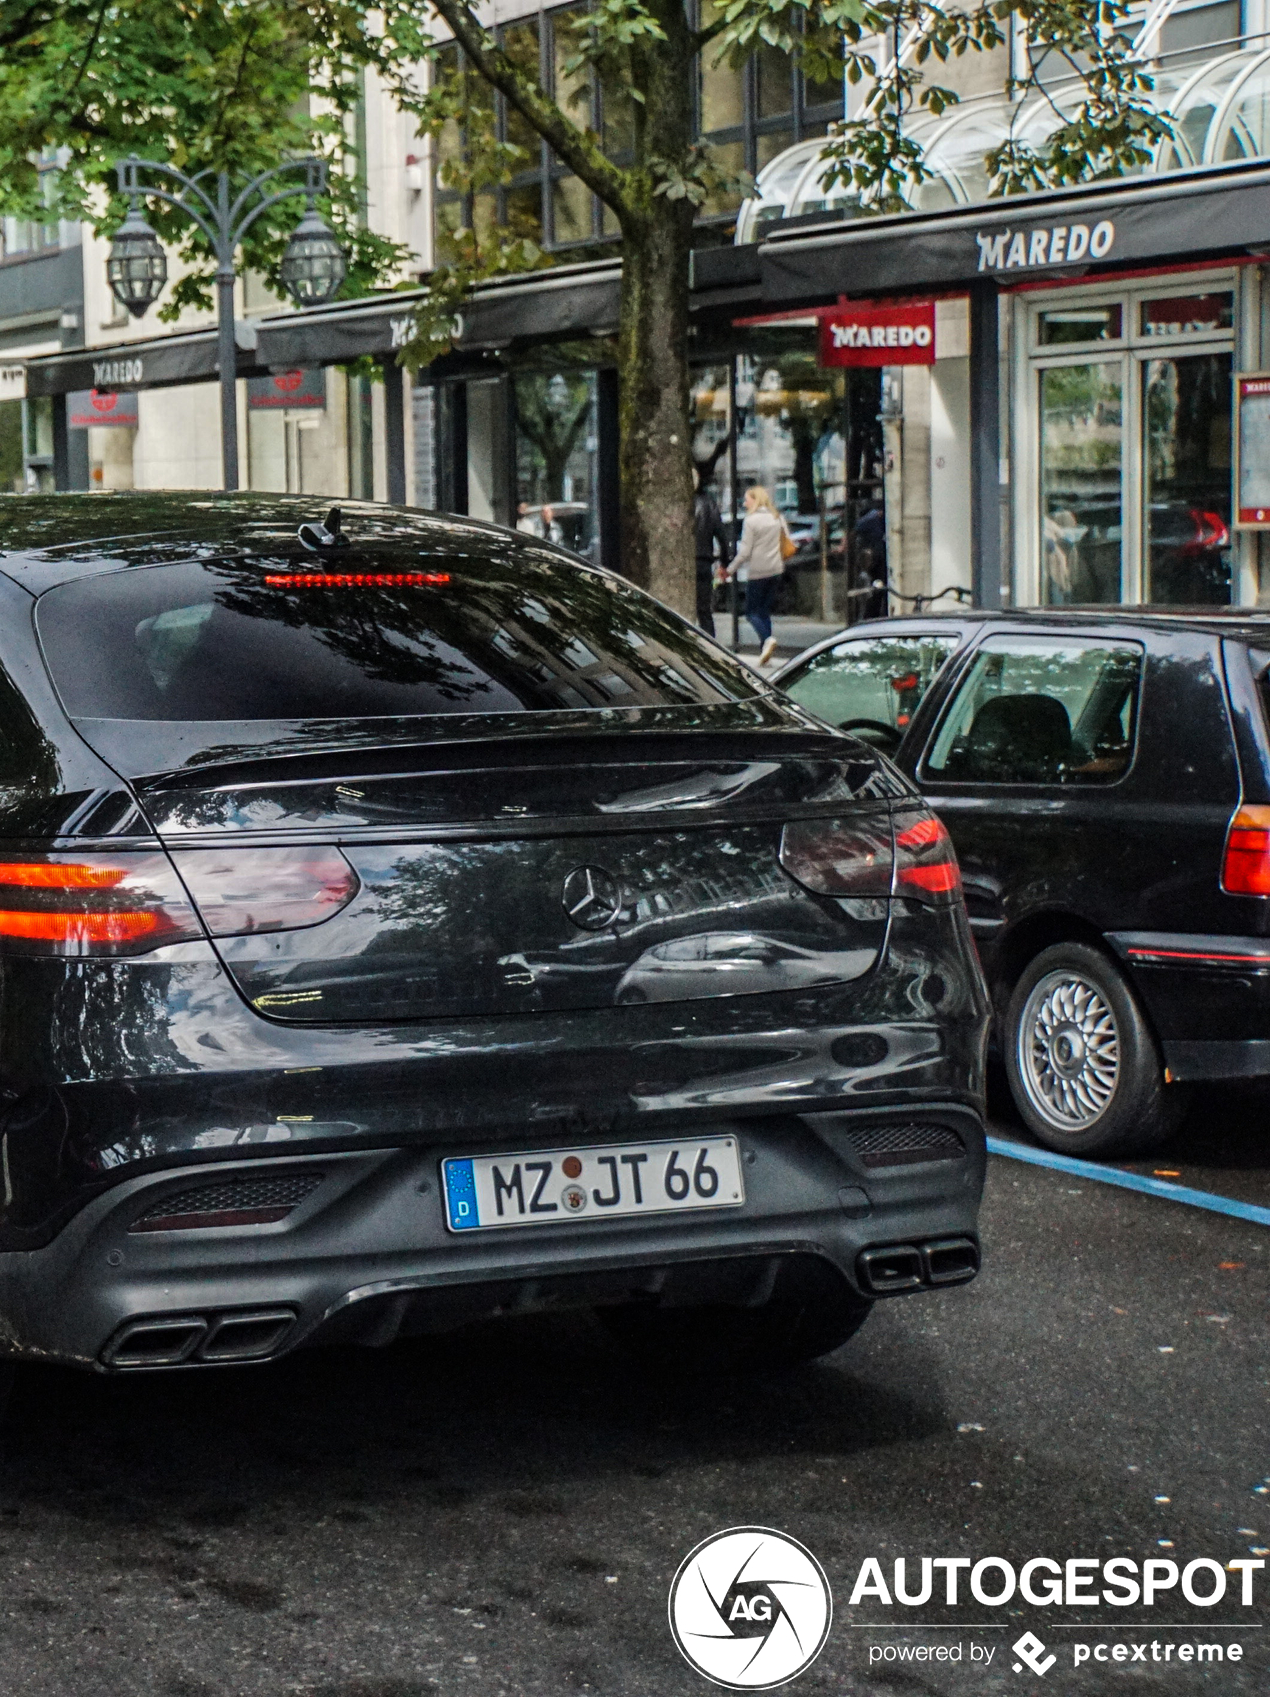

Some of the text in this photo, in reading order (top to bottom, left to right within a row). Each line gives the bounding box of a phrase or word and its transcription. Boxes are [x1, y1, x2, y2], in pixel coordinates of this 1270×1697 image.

[976, 220, 1115, 272] MAREDO
[830, 323, 931, 347] MAREDO
[92, 359, 143, 386] MAREDO
[458, 1147, 719, 1216] D MZ JT 66
